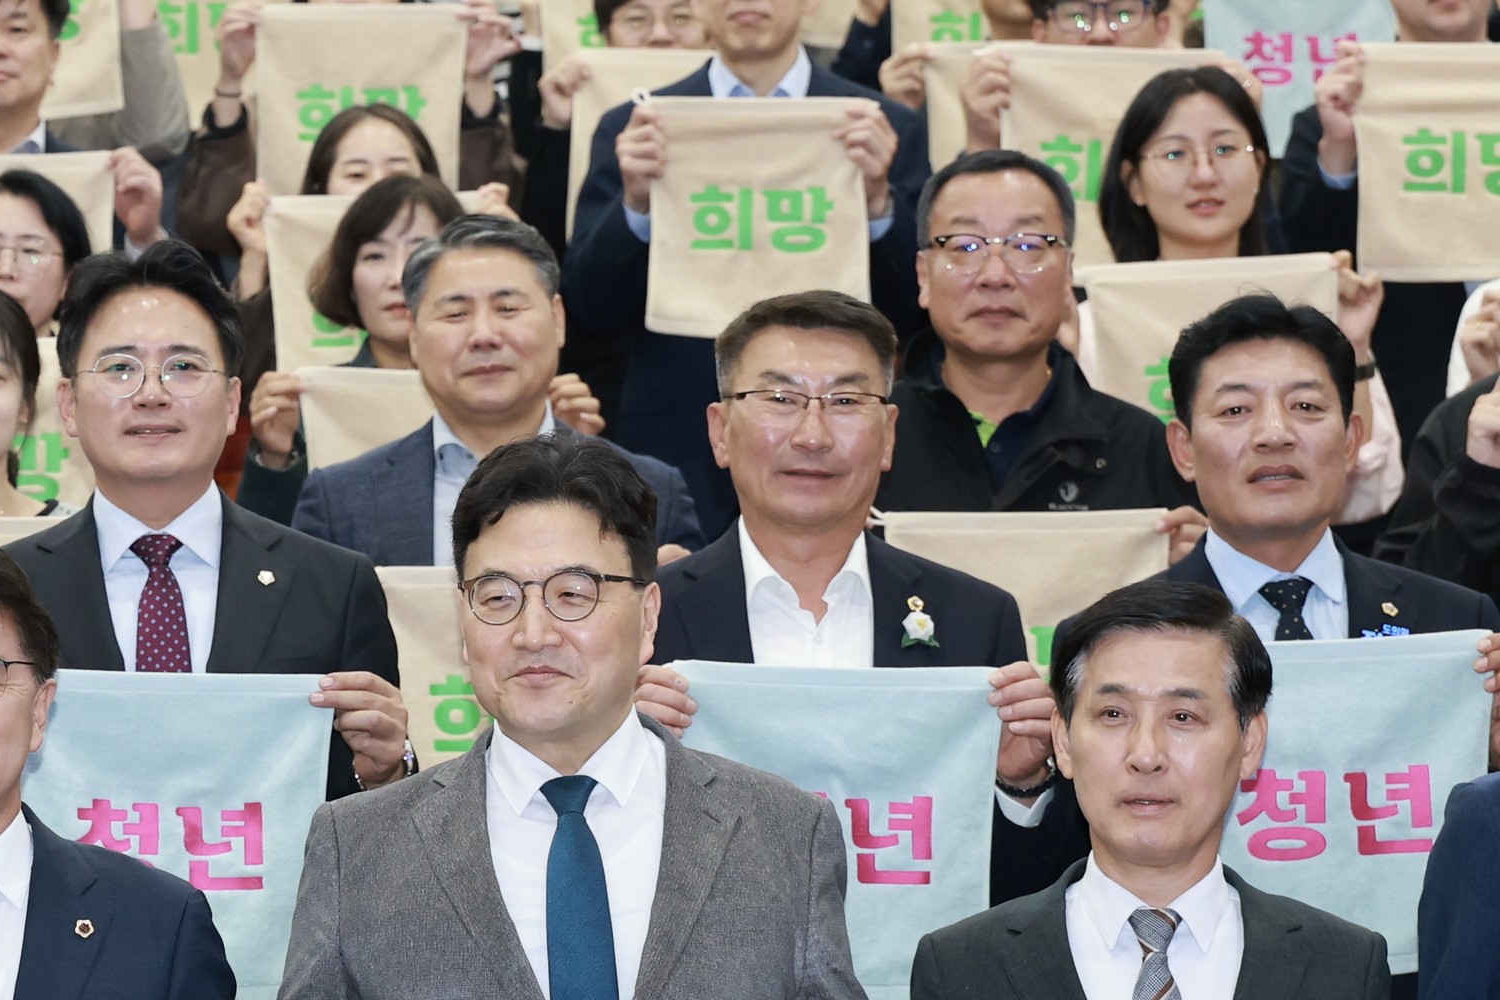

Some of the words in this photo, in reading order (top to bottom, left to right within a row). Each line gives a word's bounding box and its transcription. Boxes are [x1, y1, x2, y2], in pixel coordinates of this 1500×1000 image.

[1040, 135, 1103, 203] 희
[690, 185, 835, 254] 희망
[429, 674, 496, 753] 희
[845, 796, 933, 885] 년
[1236, 764, 1434, 861] 청년
